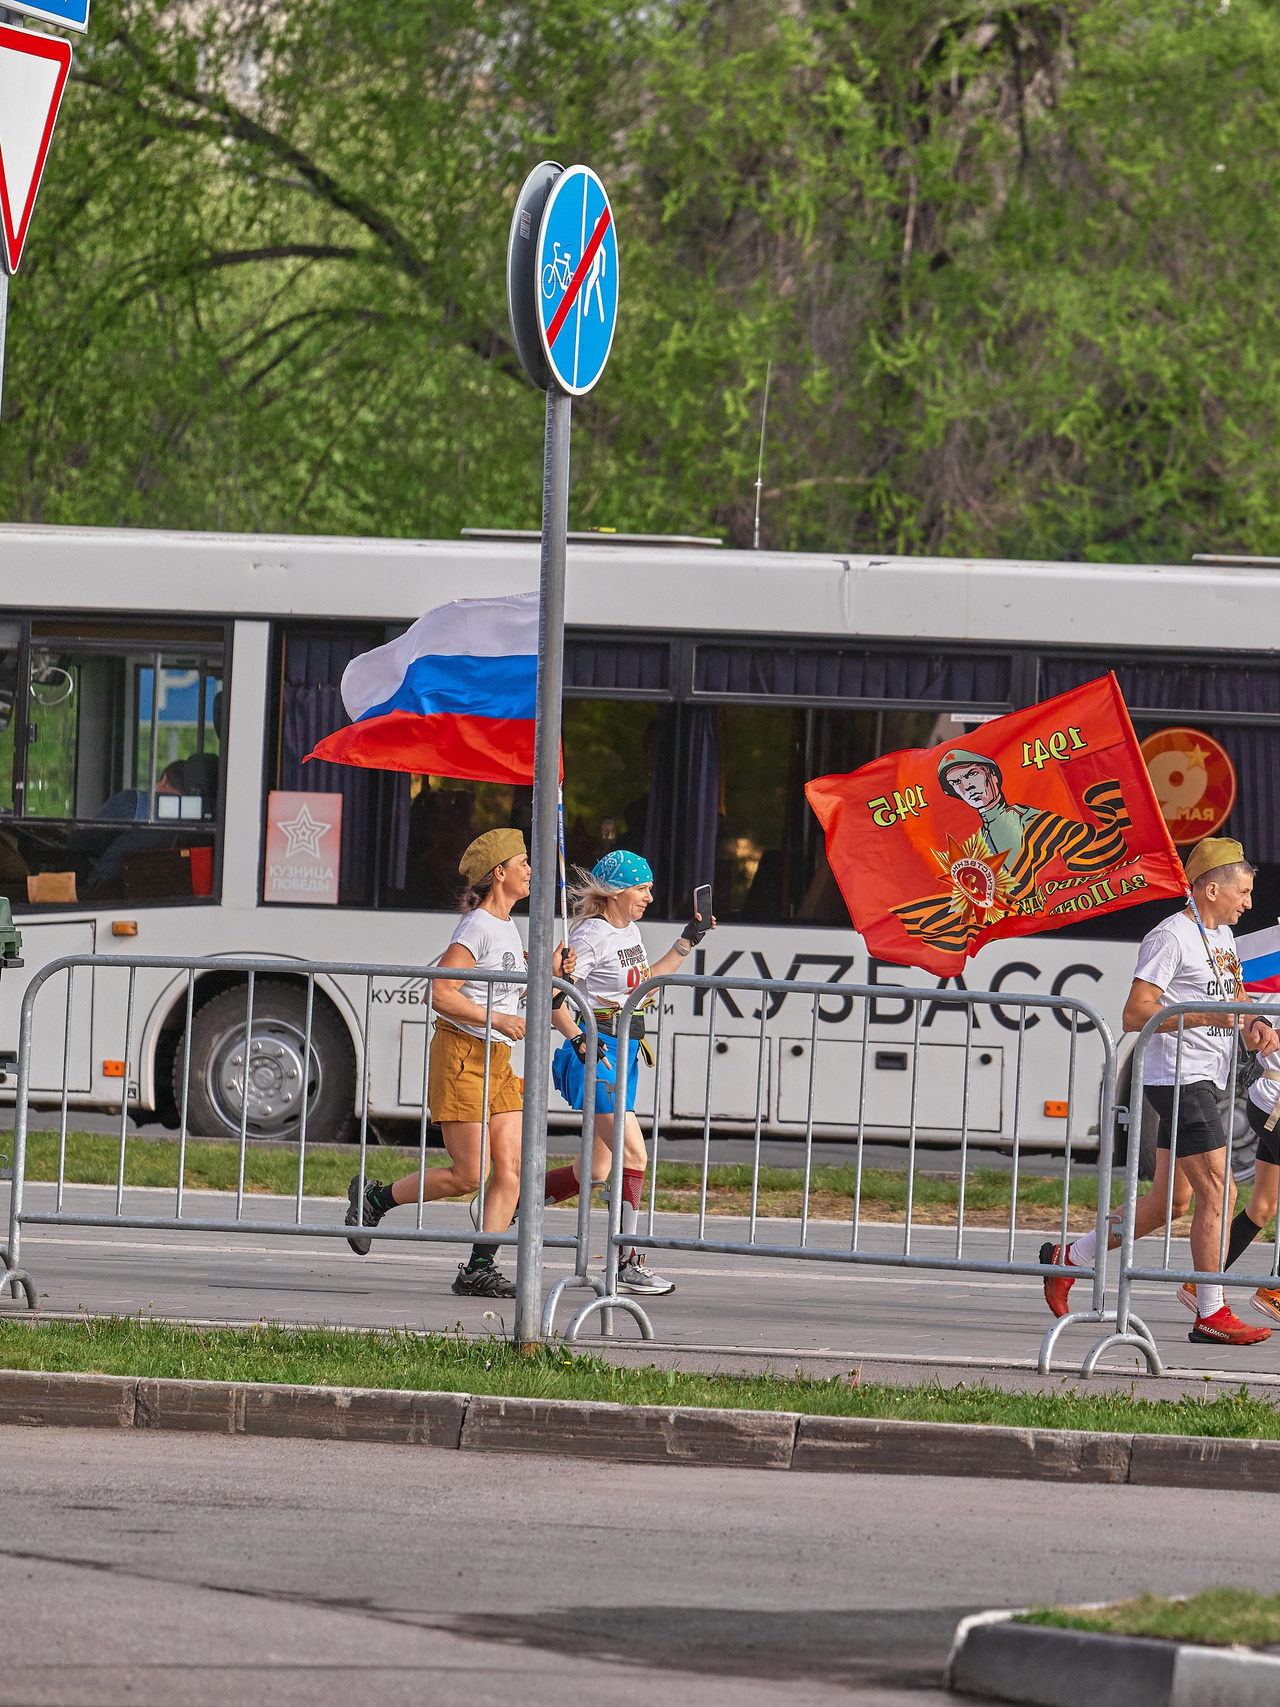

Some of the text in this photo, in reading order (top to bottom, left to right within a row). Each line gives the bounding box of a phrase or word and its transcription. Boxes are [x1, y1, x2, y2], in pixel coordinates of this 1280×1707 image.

[269, 865, 334, 880] КУЗНИЦА
[371, 989, 424, 1005] КУЗБ
[692, 949, 1103, 1033] КУЗБАСС
[1198, 1324, 1230, 1339] SALOMON
